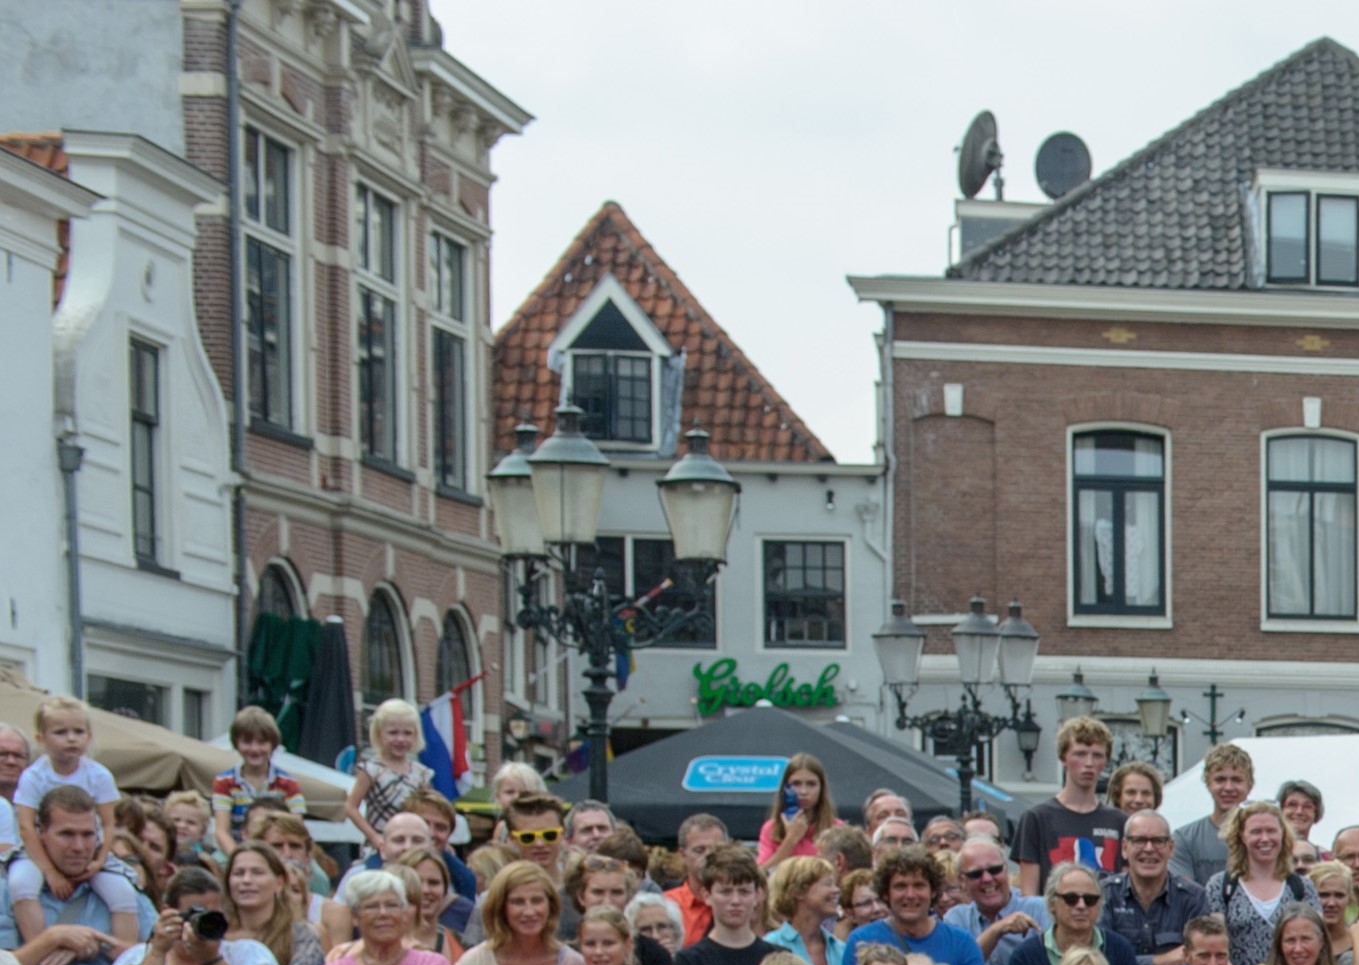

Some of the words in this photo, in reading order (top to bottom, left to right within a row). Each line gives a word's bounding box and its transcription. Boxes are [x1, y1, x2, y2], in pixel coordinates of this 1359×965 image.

[693, 658, 840, 716] Grolsch
[698, 763, 780, 776] Crystal
[704, 773, 758, 784] Clear
